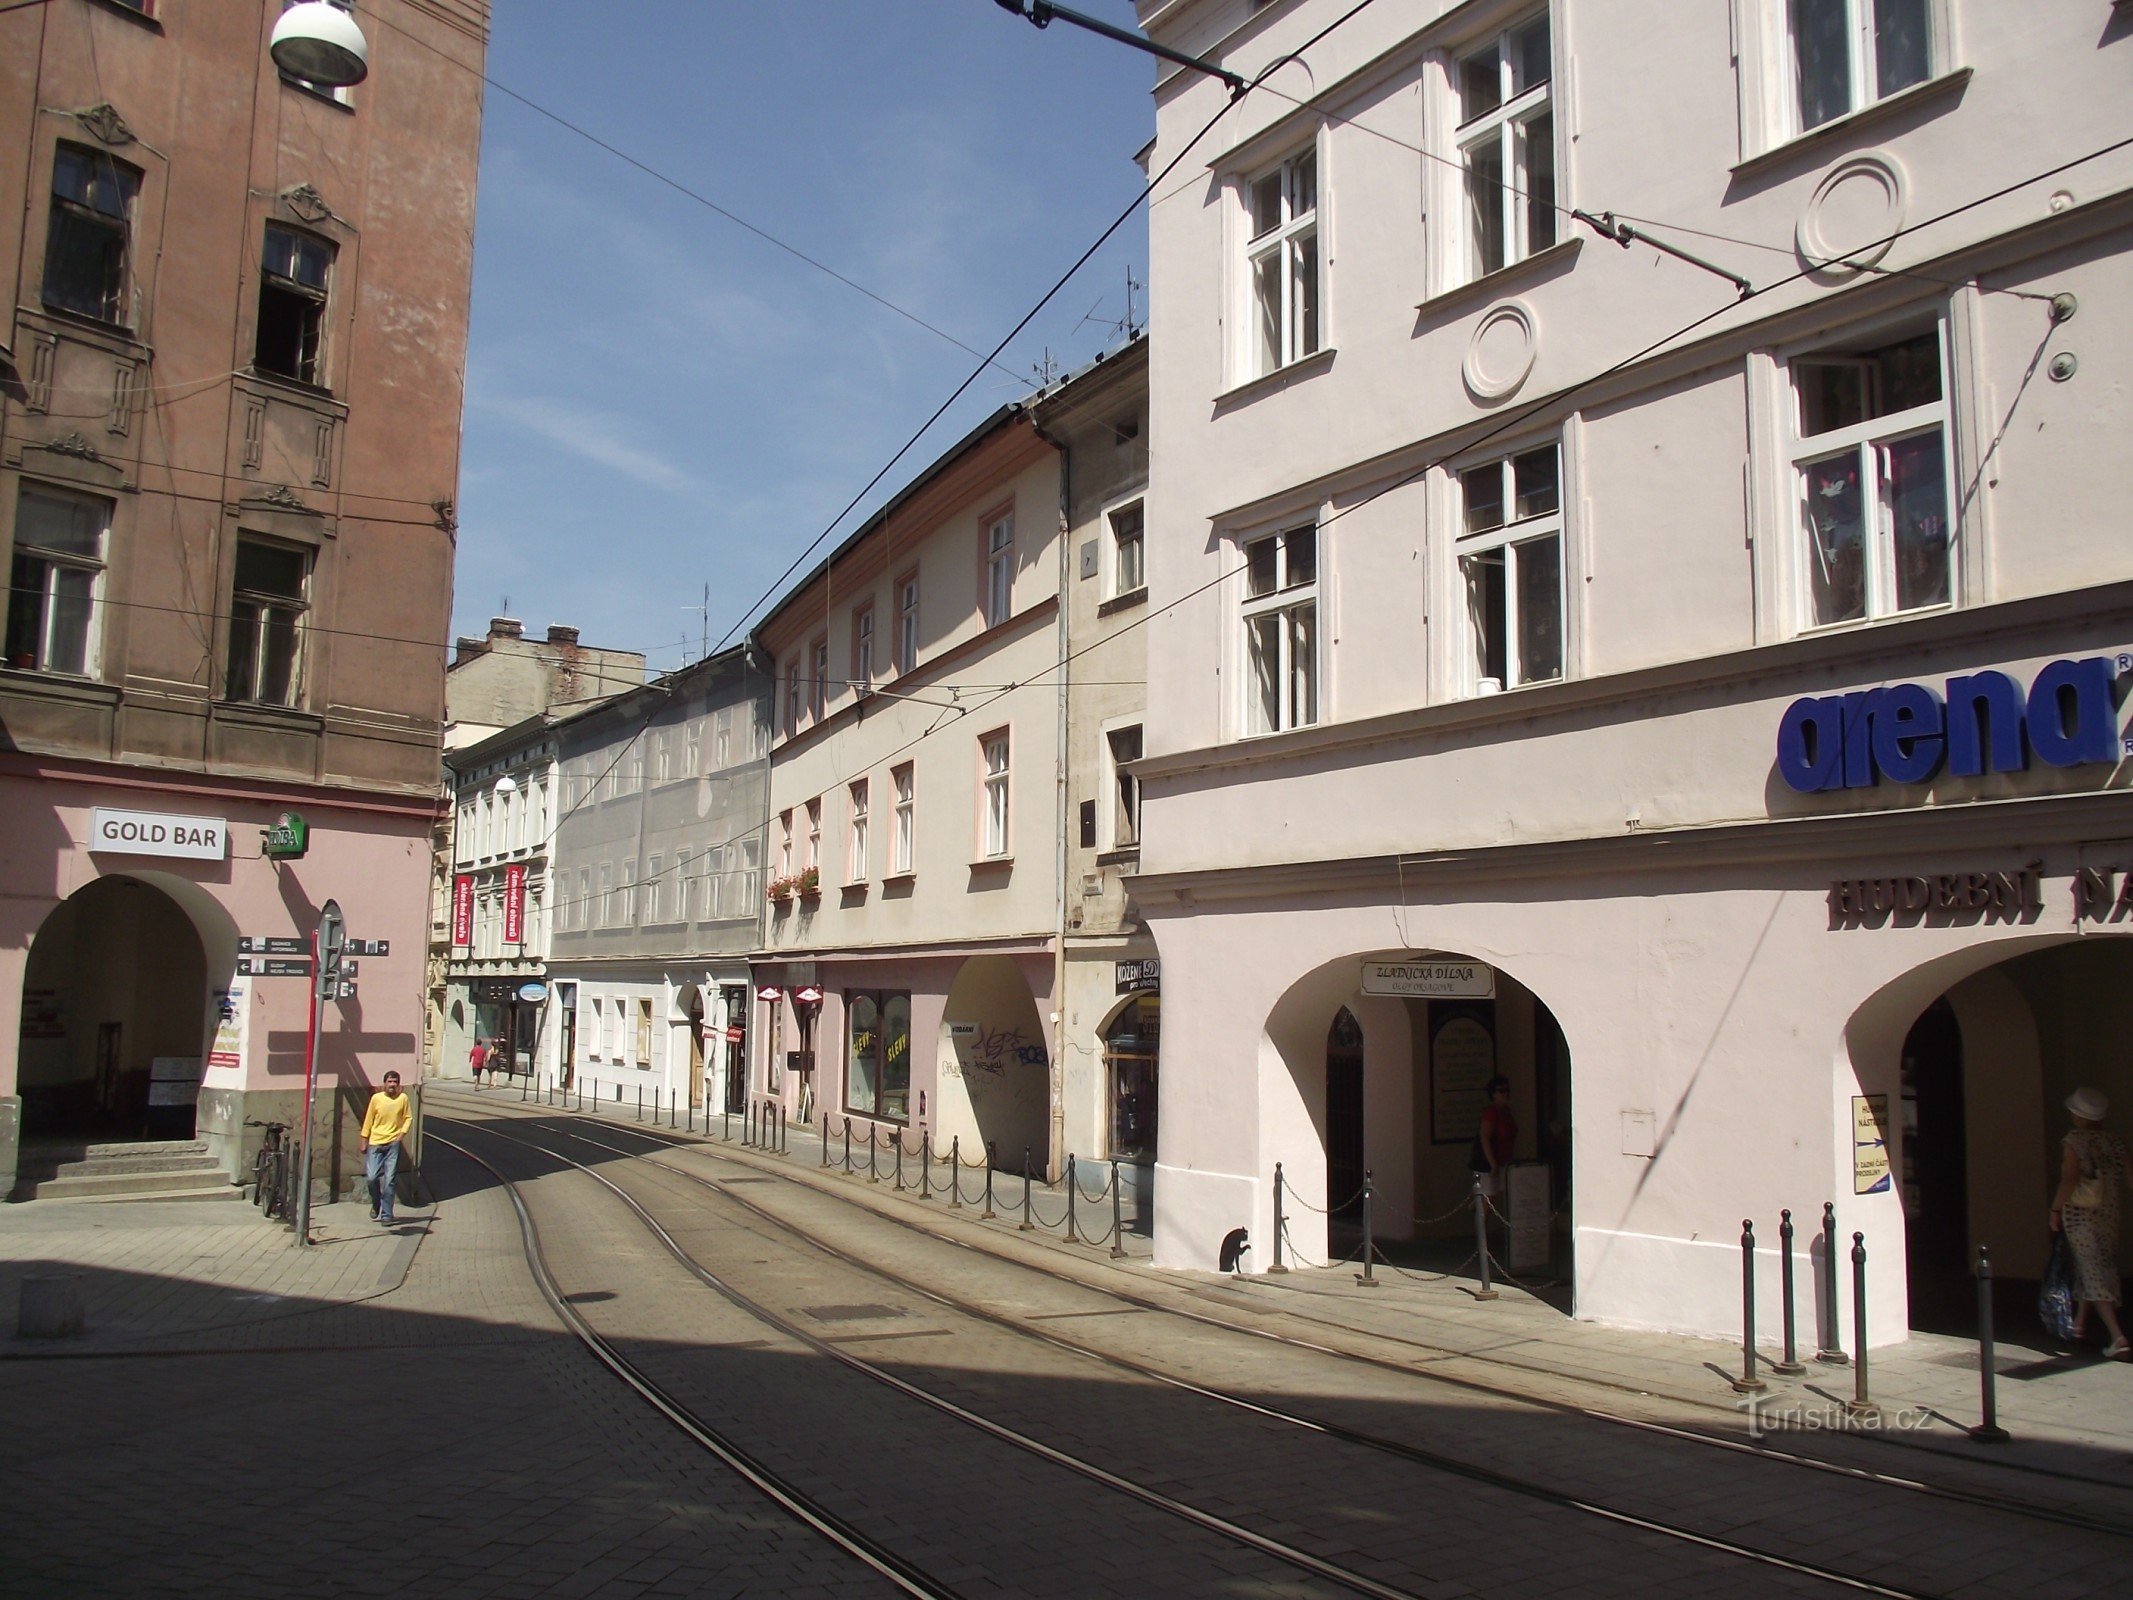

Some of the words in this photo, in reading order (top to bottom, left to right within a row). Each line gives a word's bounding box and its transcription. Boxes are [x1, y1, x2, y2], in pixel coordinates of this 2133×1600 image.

[1777, 656, 2117, 793] arena
[102, 821, 166, 843] GOLD
[173, 827, 216, 847] BAR
[1830, 858, 2044, 915] HUDEBNÍ
[1117, 961, 1142, 984] KOŽENÉ
[1129, 981, 1139, 990] pro
[1376, 966, 1433, 980] ZLATNICKÁ
[1435, 965, 1475, 981] DÍLNA
[887, 1033, 906, 1062] SLEVY
